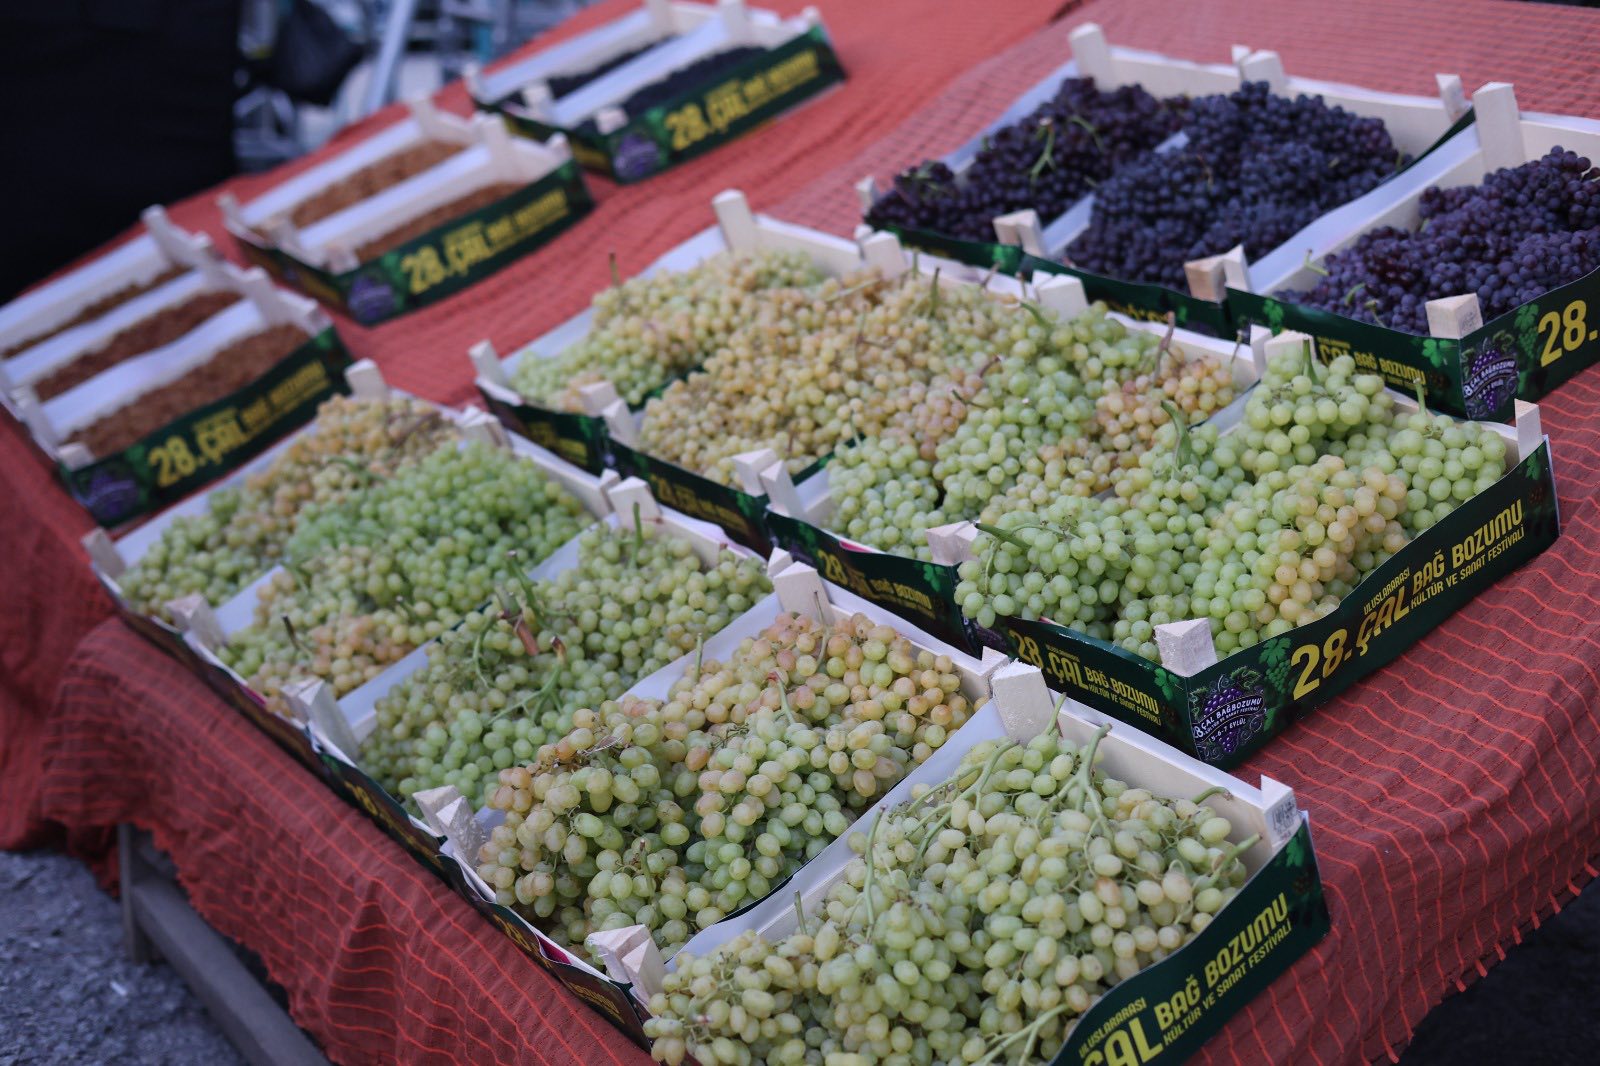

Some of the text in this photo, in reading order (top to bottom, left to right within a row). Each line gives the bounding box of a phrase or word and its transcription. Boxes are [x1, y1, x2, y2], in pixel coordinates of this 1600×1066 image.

[1538, 300, 1598, 368] 28.
[1290, 499, 1523, 701] 28. ÇAL BAĞ BOZUMU
[1363, 568, 1411, 615] ULUSLARARASI
[1411, 526, 1525, 609] KÜLTÜR VE SANAT FESTİVALİ
[1048, 652, 1090, 690] ÇAL
[1084, 666, 1108, 689] BAĞ
[1110, 677, 1160, 715] BOZUMU
[1201, 716, 1215, 730] ÇAL
[1216, 697, 1262, 719] BAĞBOZUMU
[1154, 974, 1201, 1032] BAĞ
[1204, 892, 1289, 989] BOZUMU
[1162, 919, 1293, 1046] KÜLTÜR VE SANAT FESTİVALİ
[1078, 996, 1147, 1059] ULUSLARARASI
